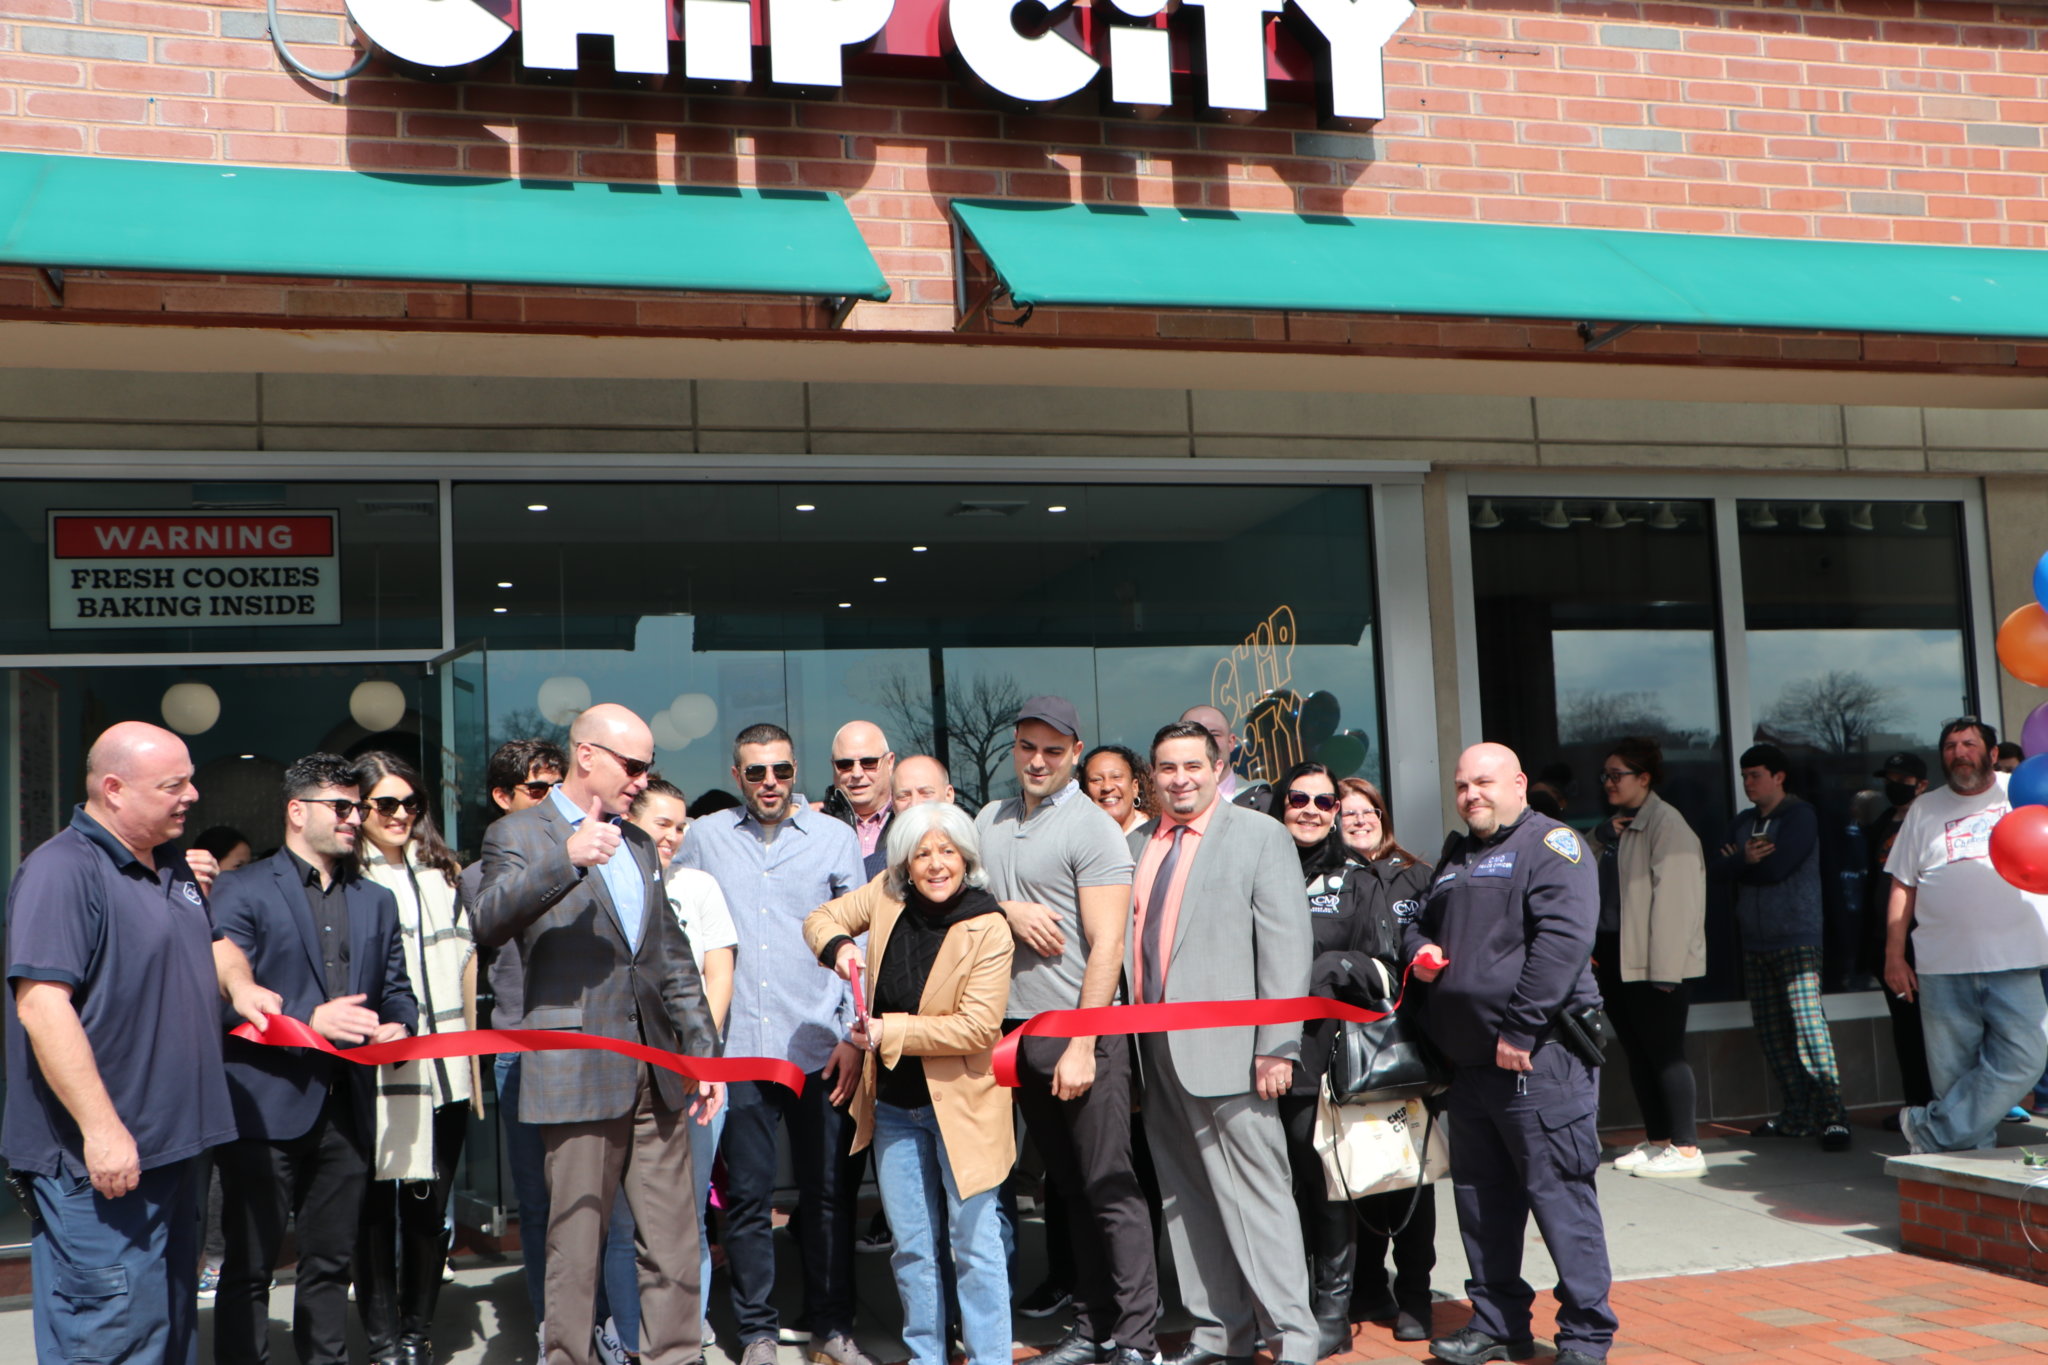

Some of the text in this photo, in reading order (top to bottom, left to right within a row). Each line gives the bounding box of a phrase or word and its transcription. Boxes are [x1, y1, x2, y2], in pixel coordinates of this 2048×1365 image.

[94, 525, 294, 551] WARNING
[71, 566, 320, 590] FRESH COOKIES
[77, 595, 316, 618] BAKING INSIDE
